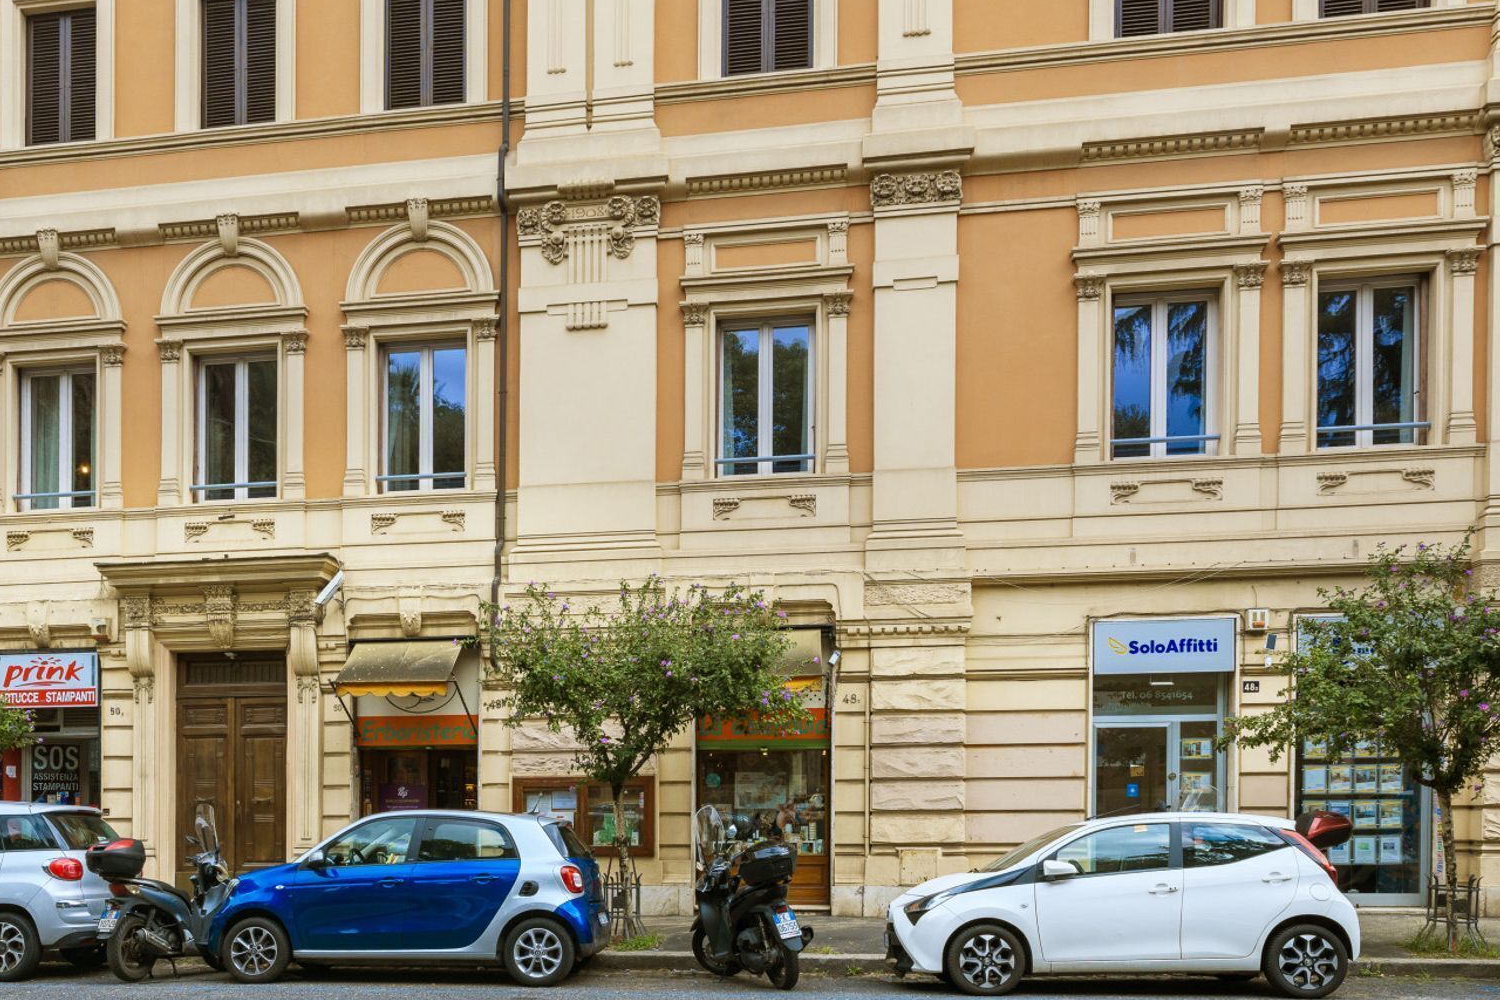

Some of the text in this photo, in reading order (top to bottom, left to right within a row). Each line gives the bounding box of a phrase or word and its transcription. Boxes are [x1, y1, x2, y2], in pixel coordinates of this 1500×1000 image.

[1128, 638, 1218, 655] SoloAffitti
[3, 659, 84, 688] prink
[45, 690, 95, 703] STAMPANTI
[362, 720, 477, 743] Erboristeria
[33, 745, 79, 770] SOS
[33, 772, 79, 781] ASSISTENZA
[32, 782, 79, 791] STAMPANTI
